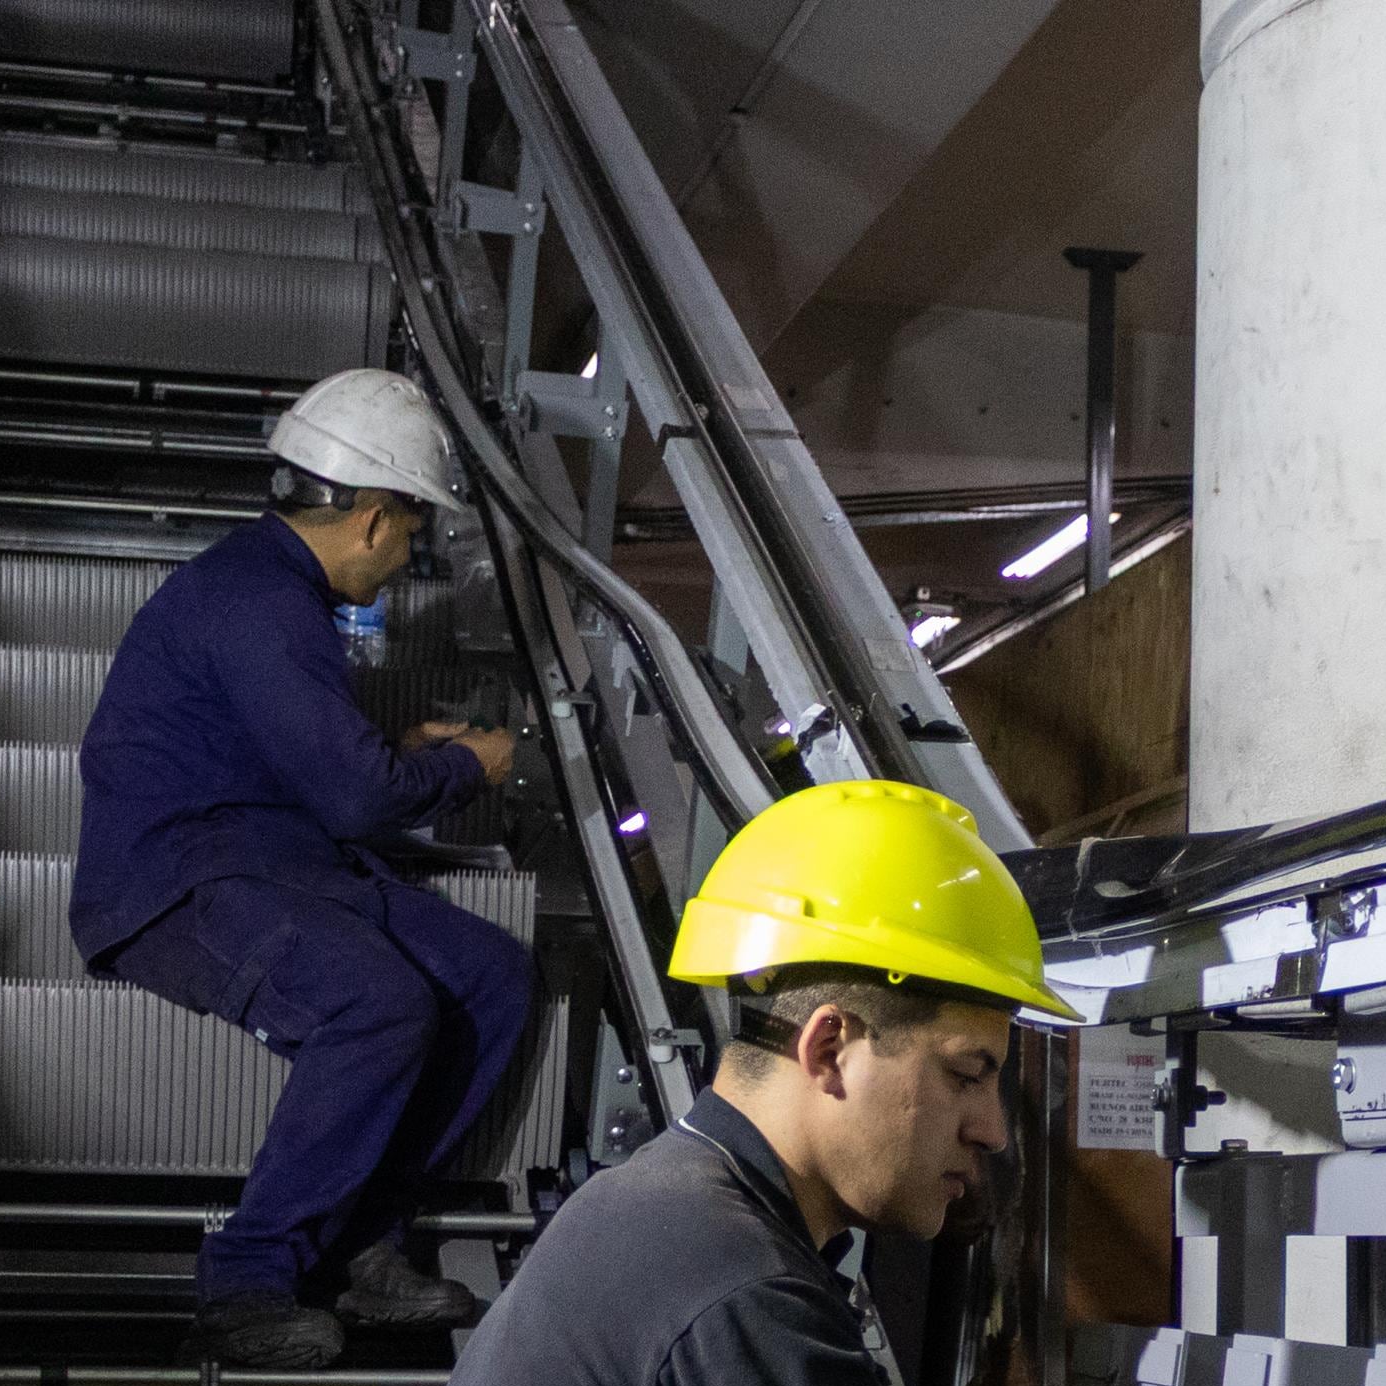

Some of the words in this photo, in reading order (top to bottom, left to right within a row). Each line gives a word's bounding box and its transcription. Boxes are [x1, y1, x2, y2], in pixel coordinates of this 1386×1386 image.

[1127, 1055, 1154, 1071] FUJITEC
[1090, 1079, 1126, 1088] FUJITEC
[1089, 1103, 1127, 1111] BUENOS
